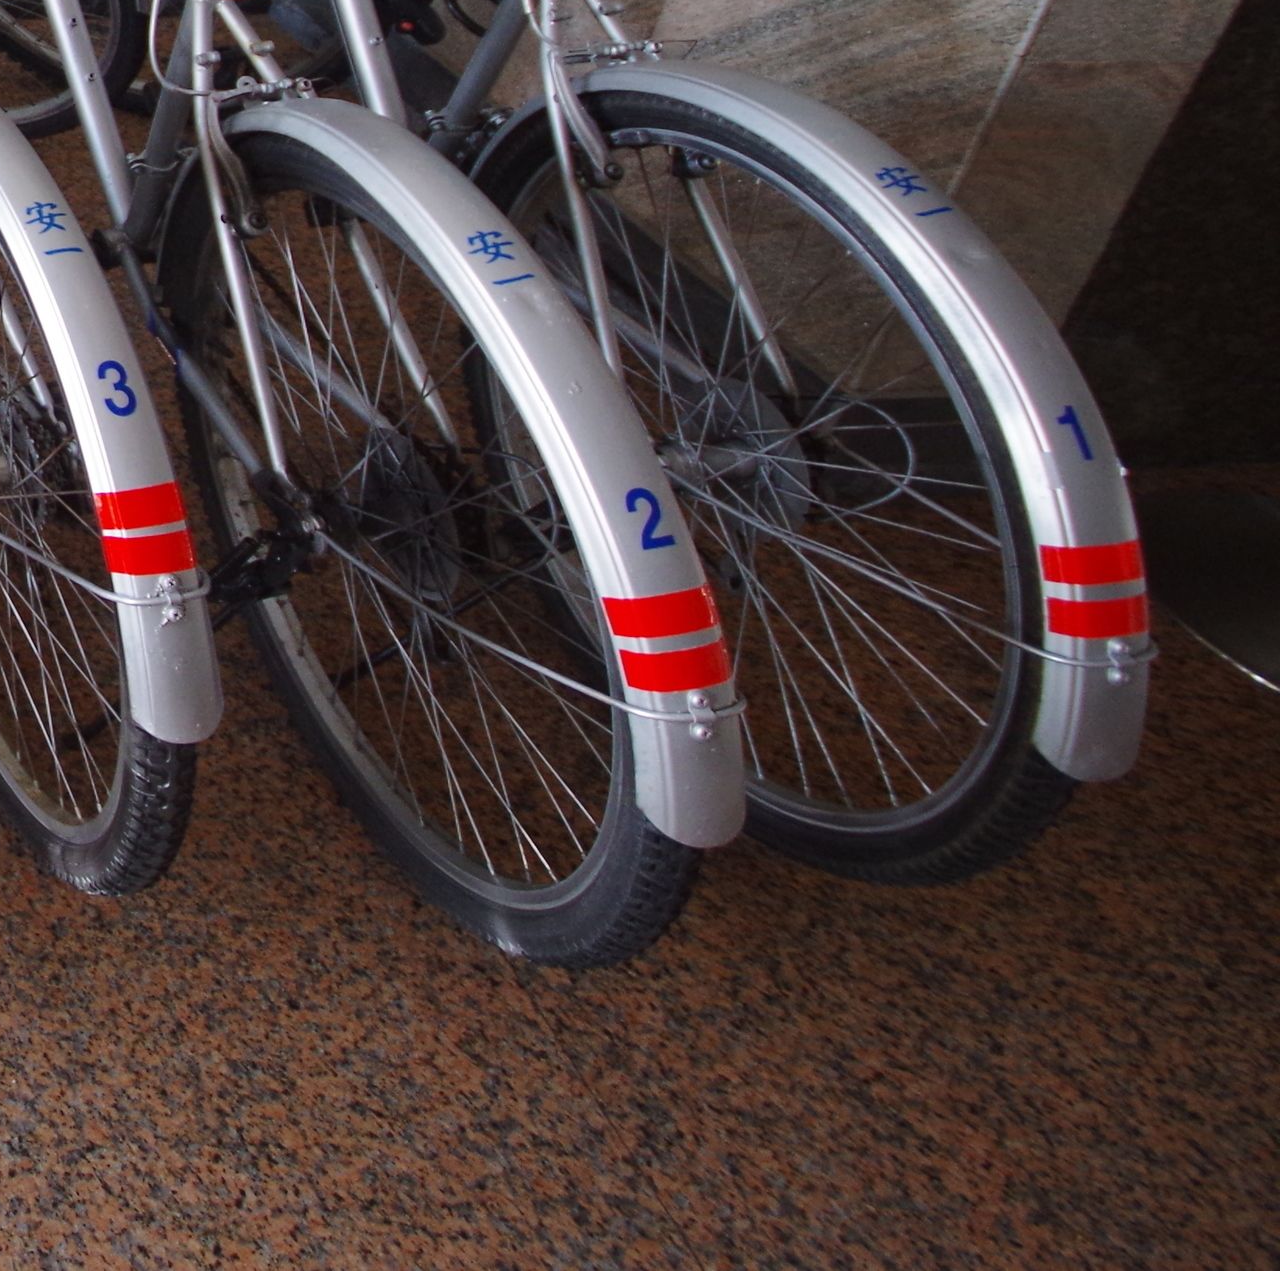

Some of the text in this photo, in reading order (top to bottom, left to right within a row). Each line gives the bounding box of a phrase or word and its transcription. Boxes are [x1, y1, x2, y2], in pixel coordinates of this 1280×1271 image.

[95, 359, 138, 418] 3
[1057, 407, 1093, 460] 1
[624, 487, 676, 552] 2
